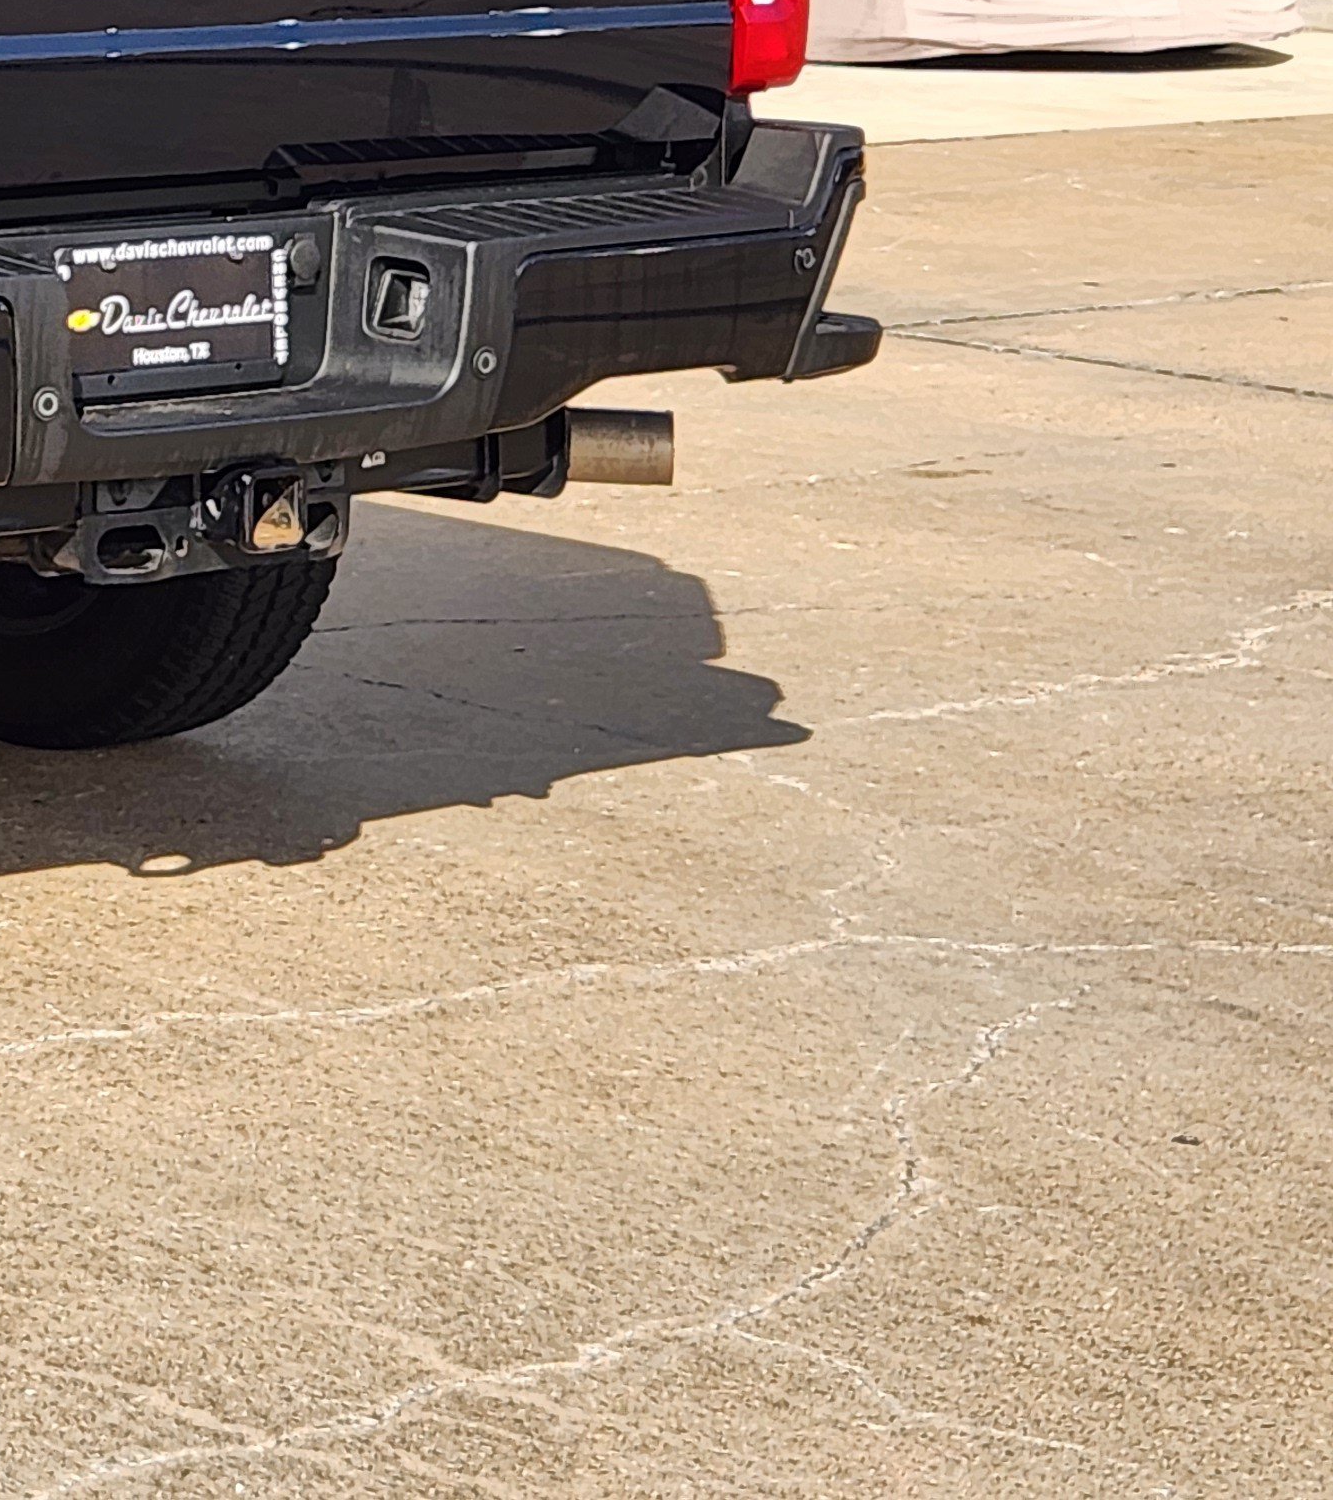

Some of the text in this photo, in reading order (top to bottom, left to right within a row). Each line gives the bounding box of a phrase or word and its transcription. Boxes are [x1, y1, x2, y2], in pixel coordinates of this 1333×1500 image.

[71, 235, 274, 265] www.davischevrolet.com
[99, 288, 275, 336] Davis Chevrolet
[189, 341, 211, 360] TX
